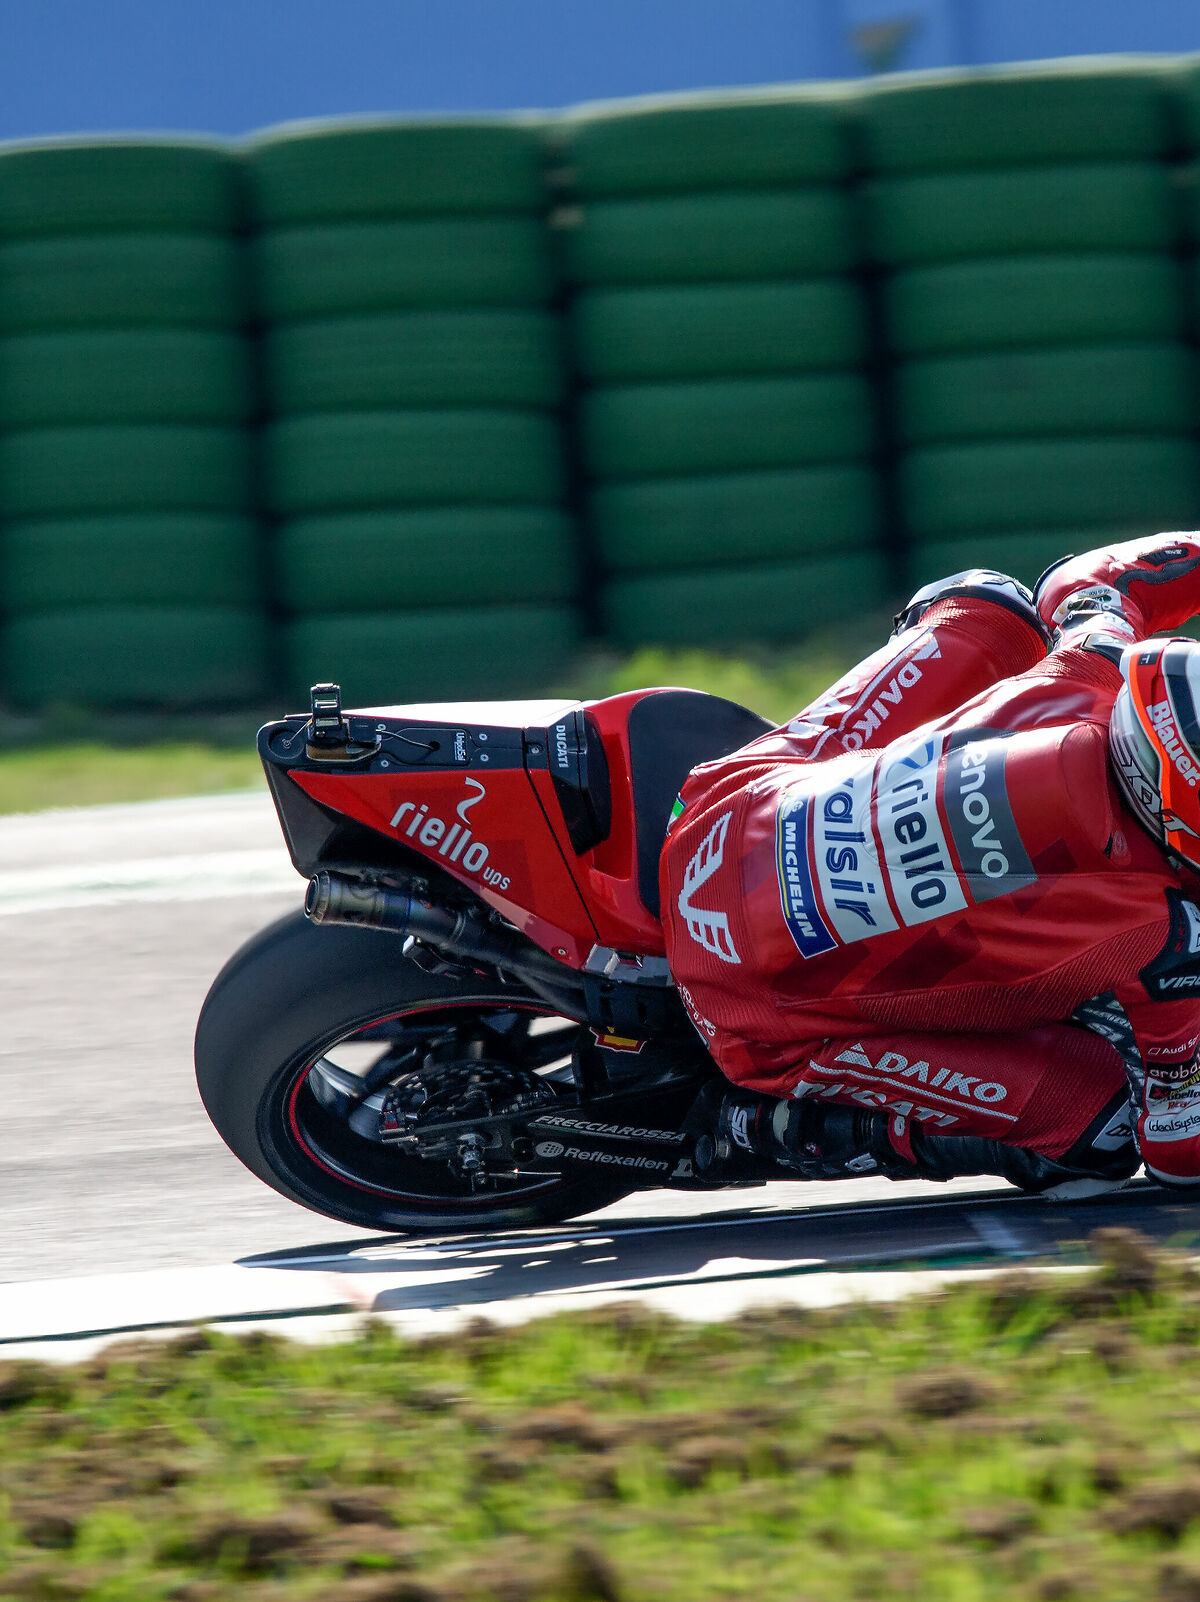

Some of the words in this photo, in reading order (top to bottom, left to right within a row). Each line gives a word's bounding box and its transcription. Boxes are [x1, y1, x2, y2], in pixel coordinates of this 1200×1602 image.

[556, 725, 569, 768] DUCATI
[841, 660, 923, 752] DAIKO
[389, 801, 489, 874] riello
[483, 864, 512, 891] ups
[892, 779, 948, 910] riello
[959, 744, 1010, 880] enovo
[783, 820, 818, 938] MICHELIN
[874, 1050, 1008, 1103] DAIKO
[534, 1115, 688, 1142] FRECCIAROSSA
[563, 1146, 669, 1171] Reflexallen
